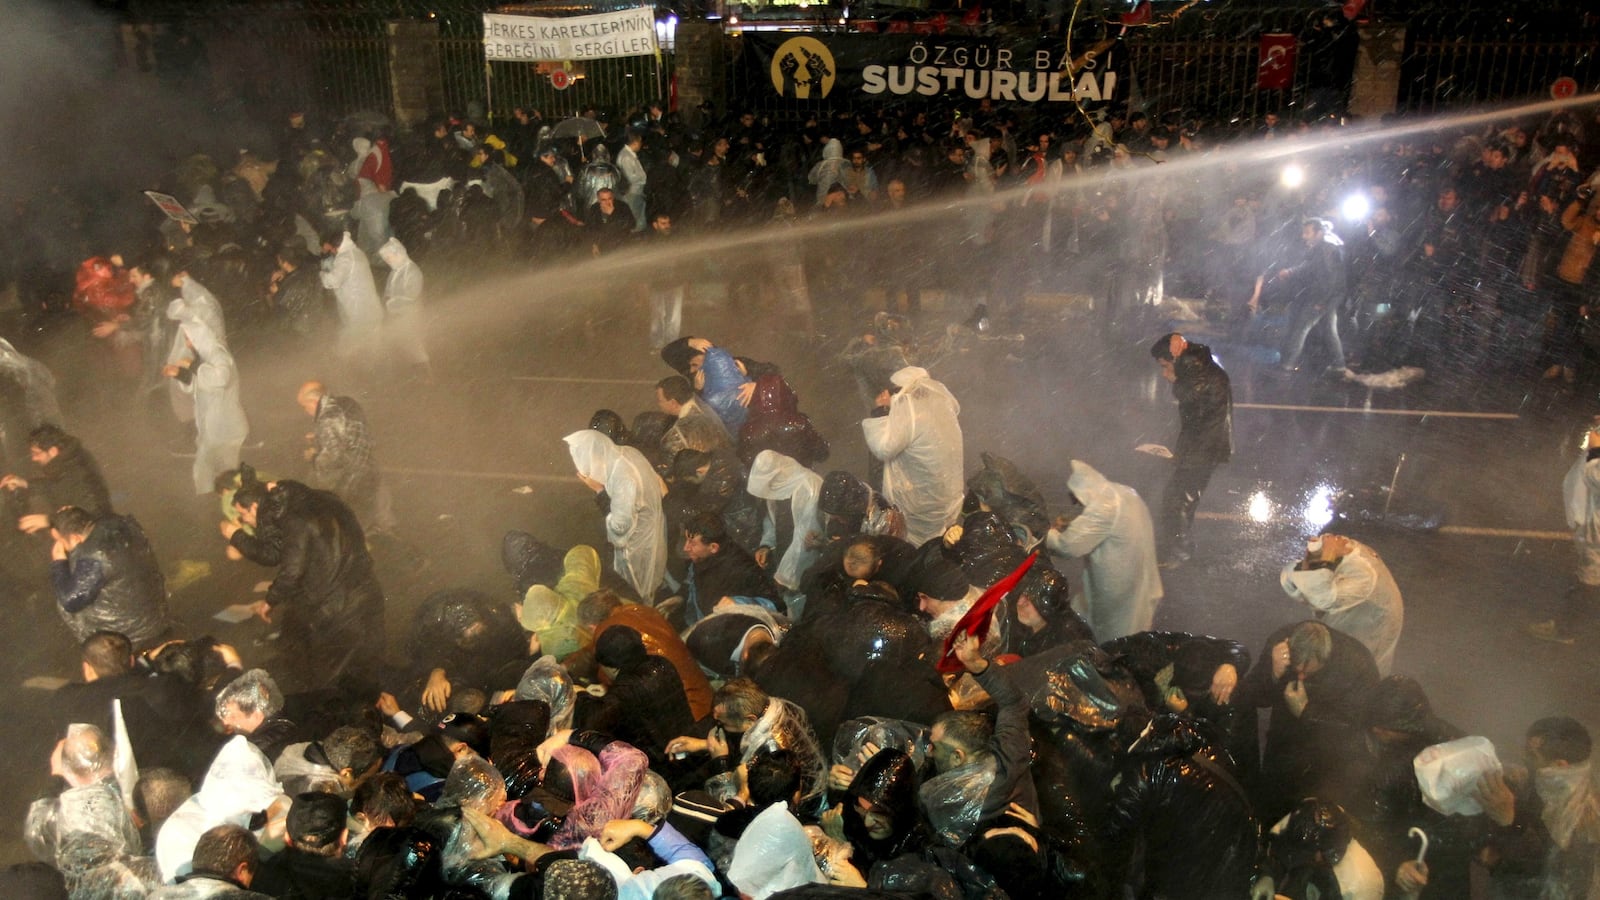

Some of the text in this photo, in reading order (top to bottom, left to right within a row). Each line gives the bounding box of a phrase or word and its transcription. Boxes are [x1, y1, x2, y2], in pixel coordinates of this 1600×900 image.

[485, 15, 651, 40] HERKES KAREKTERİNİN
[575, 37, 651, 57] SERGİLER
[909, 41, 1013, 68] ÖZGÜR
